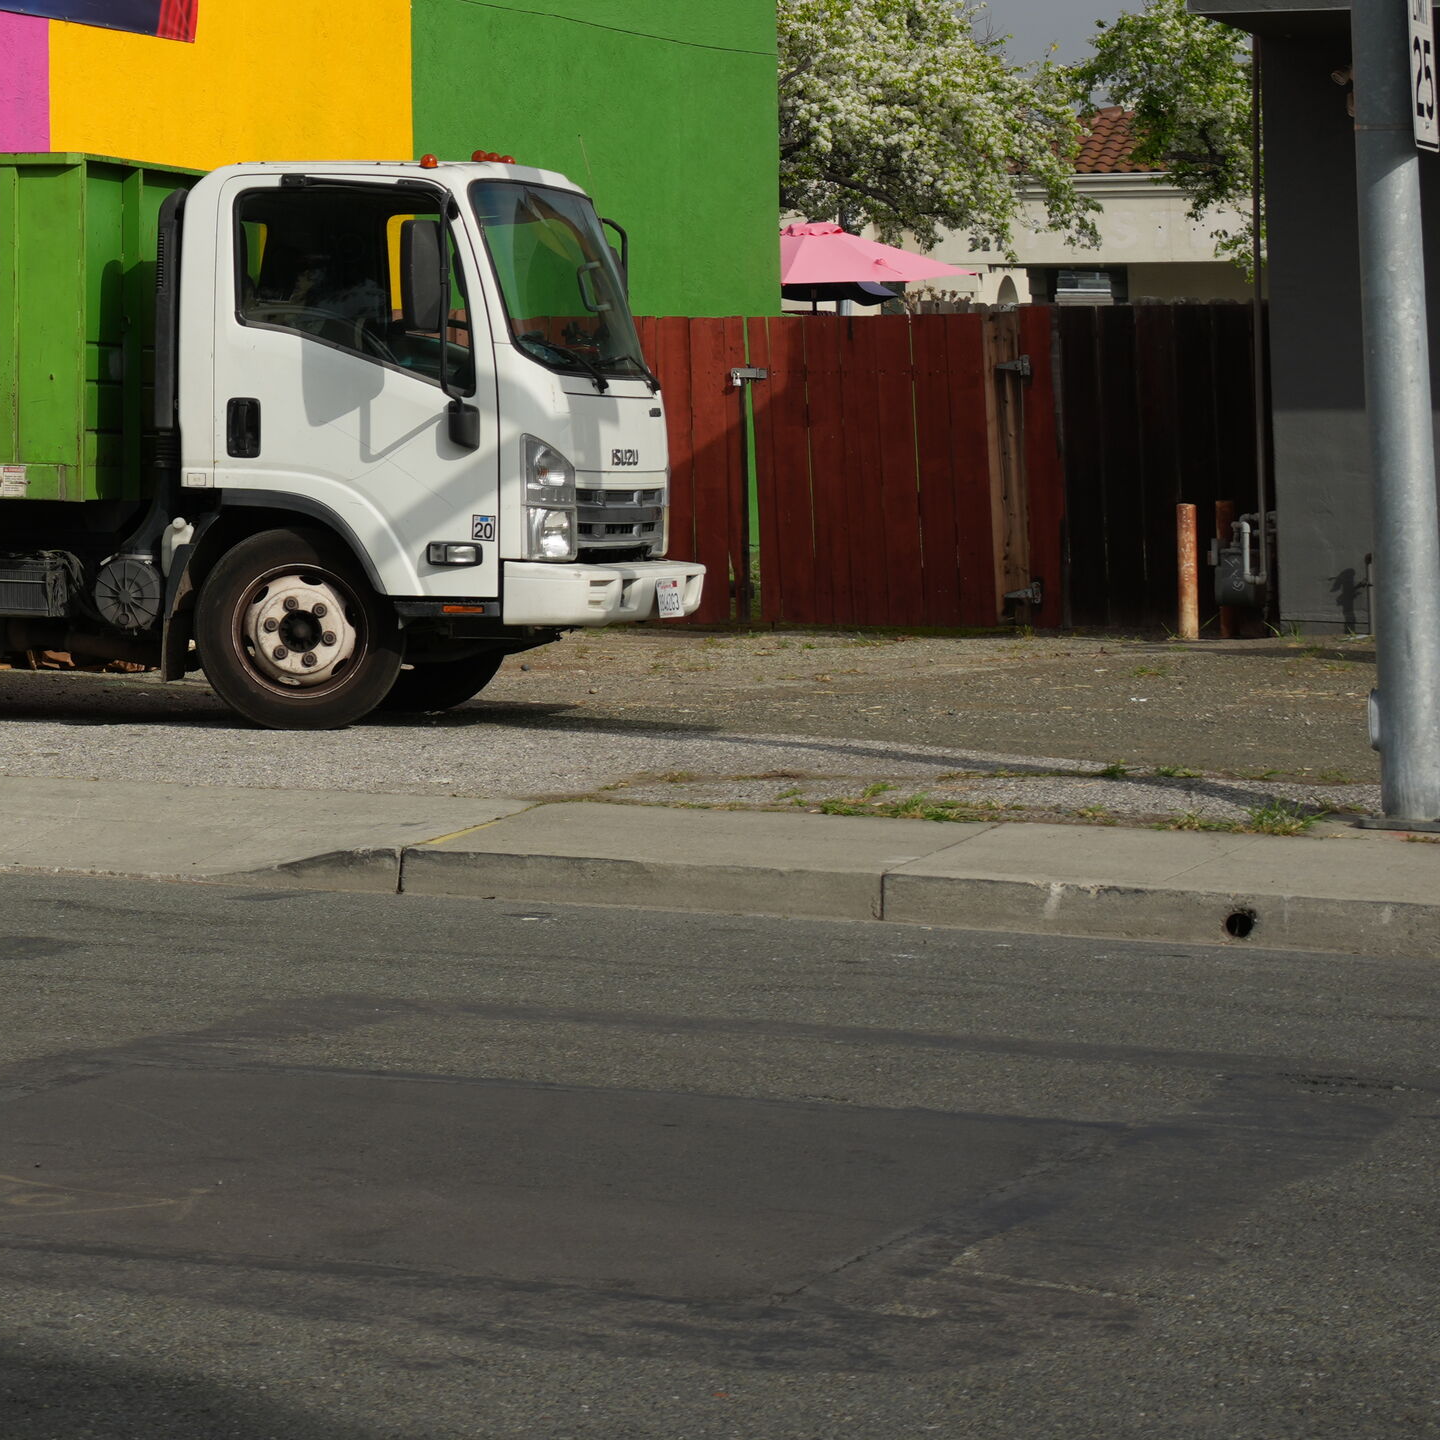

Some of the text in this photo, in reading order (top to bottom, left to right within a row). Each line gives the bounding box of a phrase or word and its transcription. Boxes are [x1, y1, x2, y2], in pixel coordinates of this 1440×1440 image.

[1413, 35, 1434, 120] 25
[611, 448, 639, 466] ISUZU
[474, 522, 493, 539] 20
